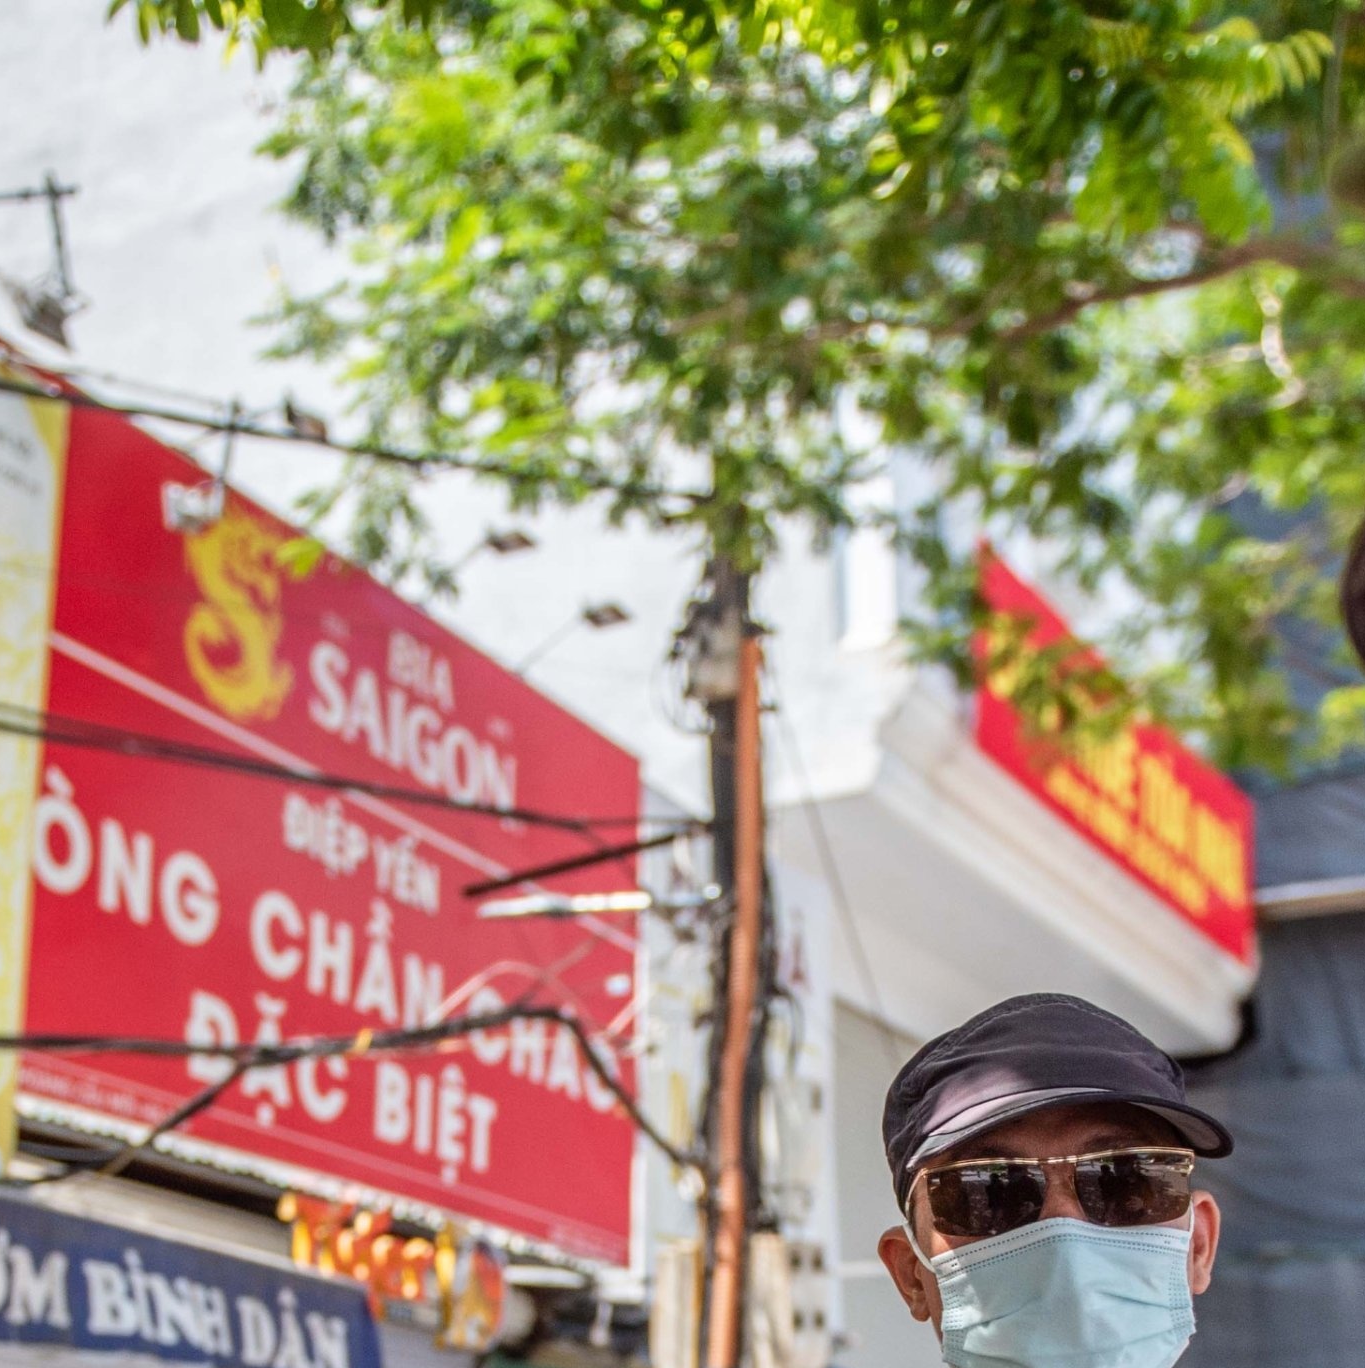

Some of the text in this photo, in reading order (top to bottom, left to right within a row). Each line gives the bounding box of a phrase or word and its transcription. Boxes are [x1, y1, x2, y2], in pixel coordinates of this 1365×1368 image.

[388, 630, 455, 712] BIA
[373, 1062, 498, 1187] BIỆT
[82, 1247, 234, 1358] BÌNH
